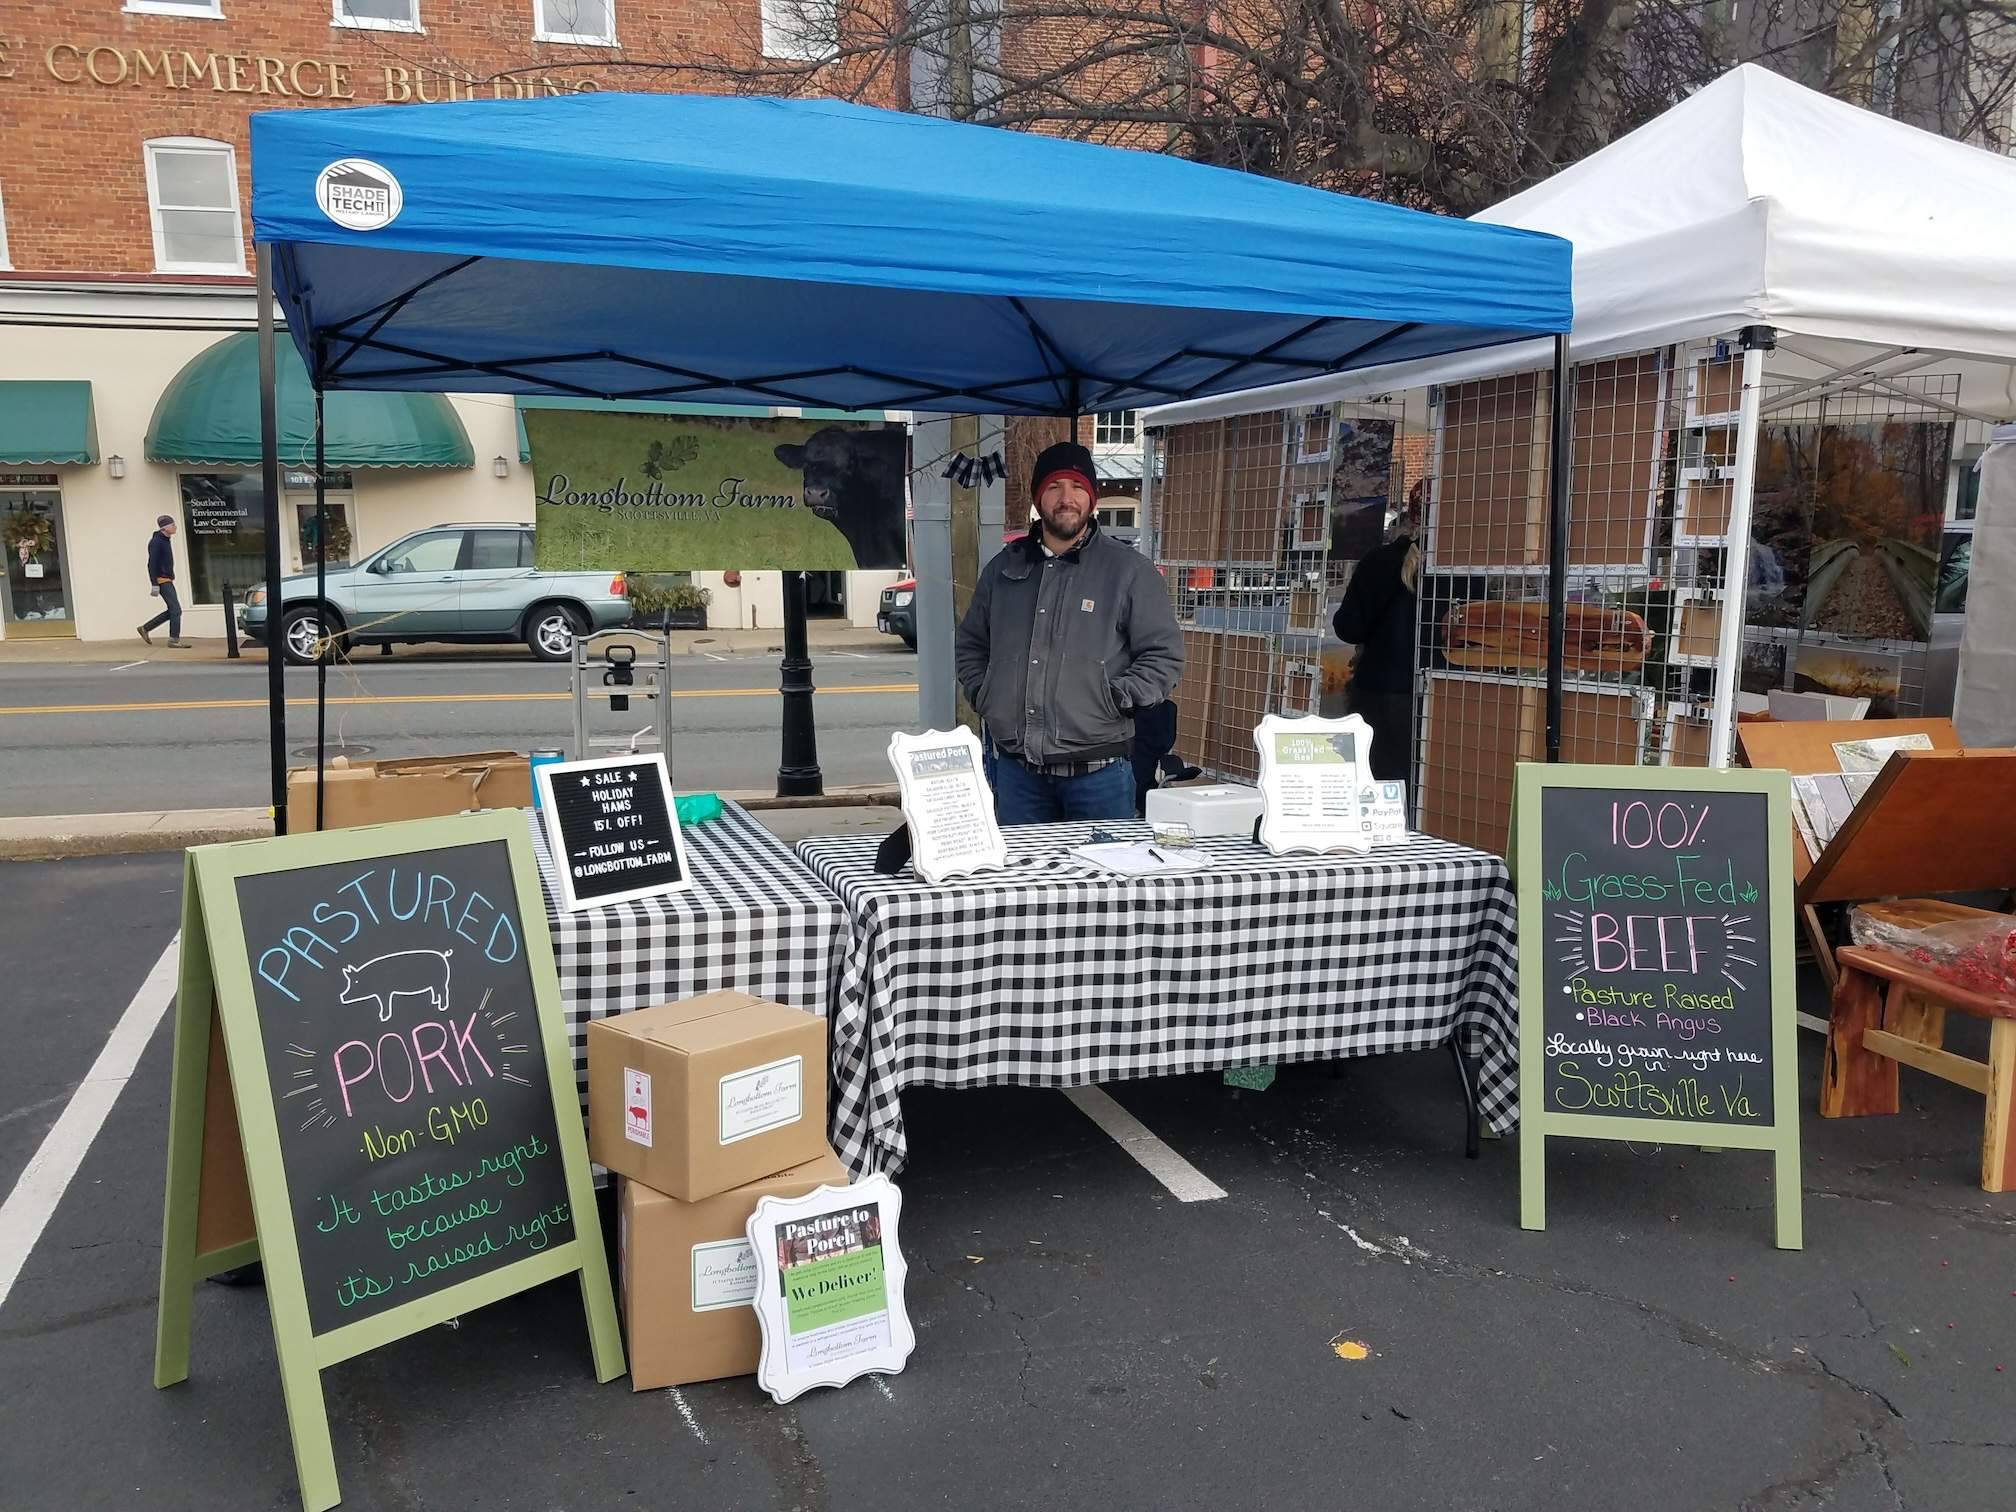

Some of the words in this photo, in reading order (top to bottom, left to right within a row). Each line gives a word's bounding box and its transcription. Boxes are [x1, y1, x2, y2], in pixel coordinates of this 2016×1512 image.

[46, 43, 356, 100] COMMERCE
[332, 186, 385, 201] SHADE
[191, 498, 226, 507] Southern
[536, 474, 706, 512] Longbottom
[712, 478, 797, 508] Farm
[192, 508, 248, 517] Environmental
[193, 518, 209, 527] Law
[210, 518, 236, 527] Center
[947, 746, 969, 757] Pork
[592, 787, 634, 802] HOLIDAY
[595, 772, 623, 785] SALE
[602, 800, 632, 813] HAMS
[617, 815, 643, 828] OFF!
[1612, 801, 1709, 848] 100%
[574, 851, 672, 878] @LONGBOTTOM_FARM
[589, 842, 625, 858] FOLLOW
[630, 839, 645, 851] US
[1562, 852, 1737, 911] Grass-Fed
[258, 868, 518, 1002] PASTURED
[1591, 913, 1717, 974] BEEF
[1571, 978, 1657, 1009] Pasture
[1664, 984, 1735, 1010] Raised
[1586, 1007, 1647, 1027] Black
[1656, 1012, 1722, 1040] Angus
[334, 1012, 494, 1117] PORK
[1545, 1032, 1613, 1067] Locally
[1617, 1043, 1673, 1067] grown
[1674, 1047, 1721, 1070] right
[1725, 1044, 1763, 1064] here
[1555, 1061, 1715, 1118] Scottsville
[363, 1098, 489, 1162] Non-GMO
[370, 1172, 473, 1216] tastes
[477, 1135, 548, 1187] right
[387, 1198, 502, 1249] because
[785, 1214, 850, 1241] Pasture
[852, 1209, 869, 1224] to
[402, 1231, 503, 1284] raised
[505, 1204, 570, 1250] right
[807, 1228, 856, 1255] Porch
[791, 1286, 815, 1301] We
[819, 1266, 877, 1295] Deliver!
